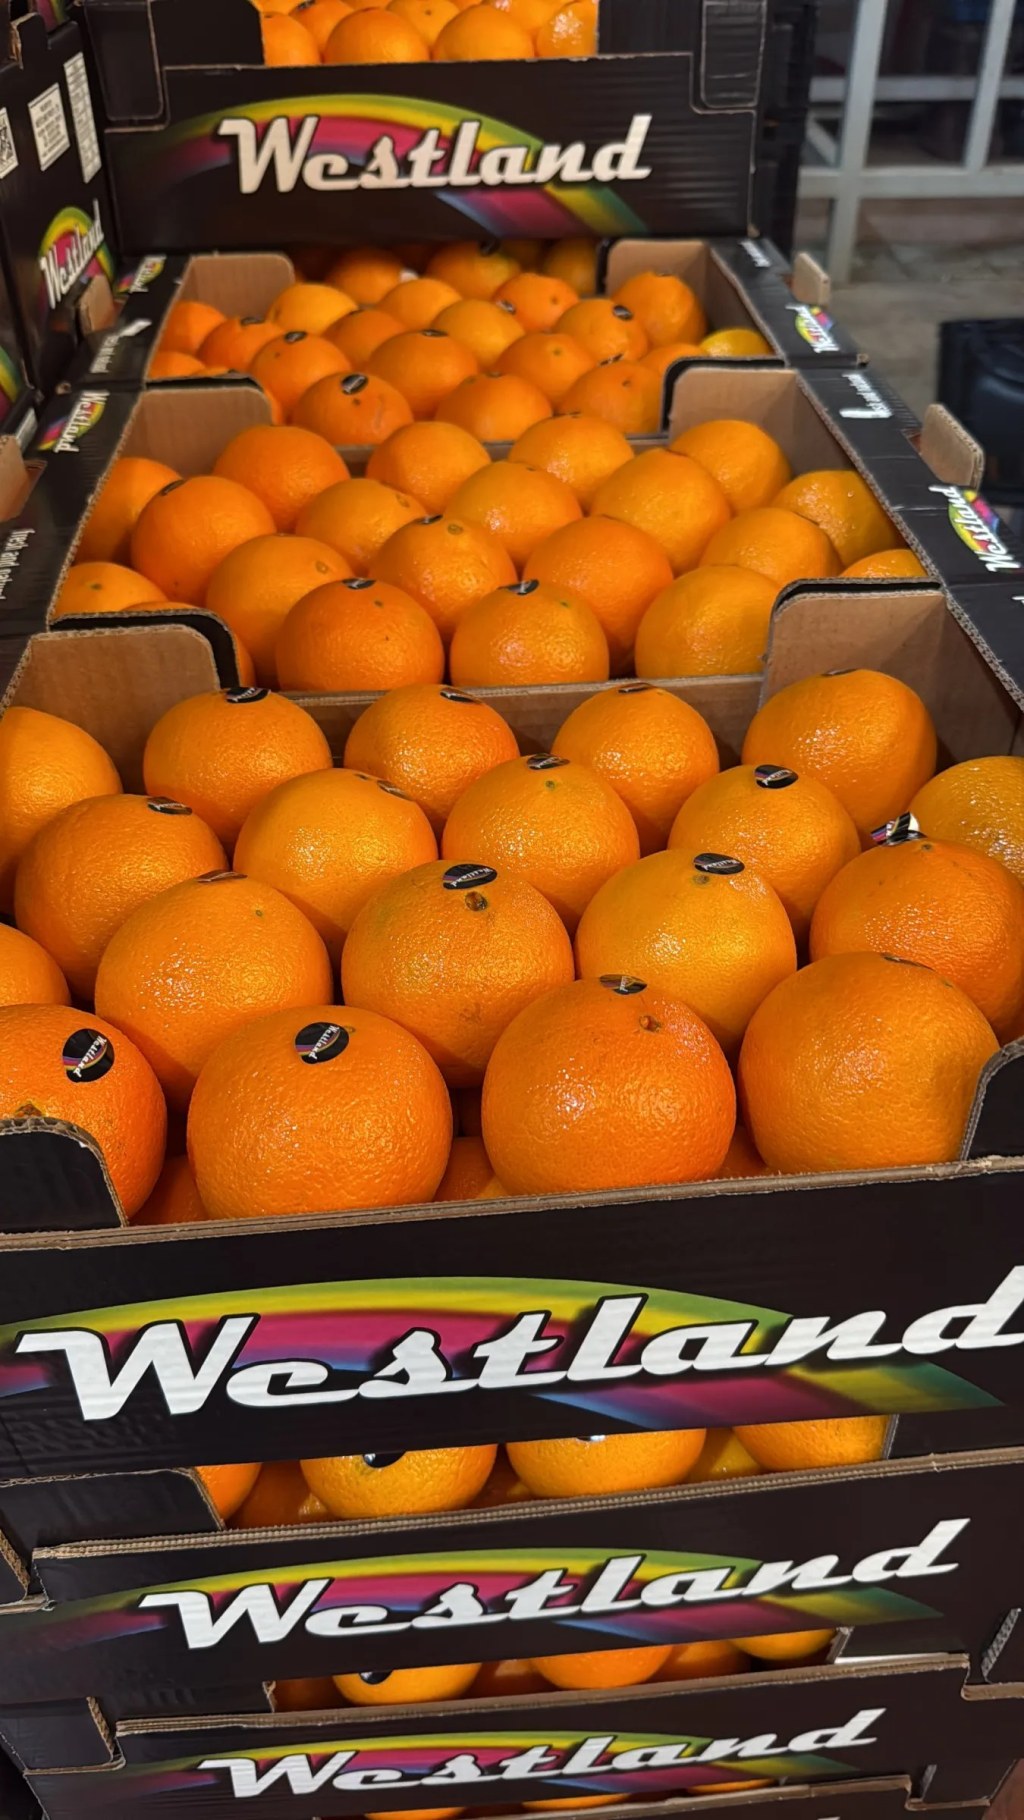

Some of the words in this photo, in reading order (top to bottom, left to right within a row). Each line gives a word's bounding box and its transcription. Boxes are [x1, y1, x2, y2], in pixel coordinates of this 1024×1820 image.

[218, 113, 653, 194] Westland
[40, 198, 105, 310] Westland
[54, 390, 110, 453] Westland
[928, 486, 1021, 573] Westland
[73, 1035, 107, 1078] Westland
[308, 1025, 340, 1060] Westland
[15, 1265, 1024, 1421] Westland
[138, 1518, 971, 1649] Westland
[198, 1708, 887, 1798] Westland
